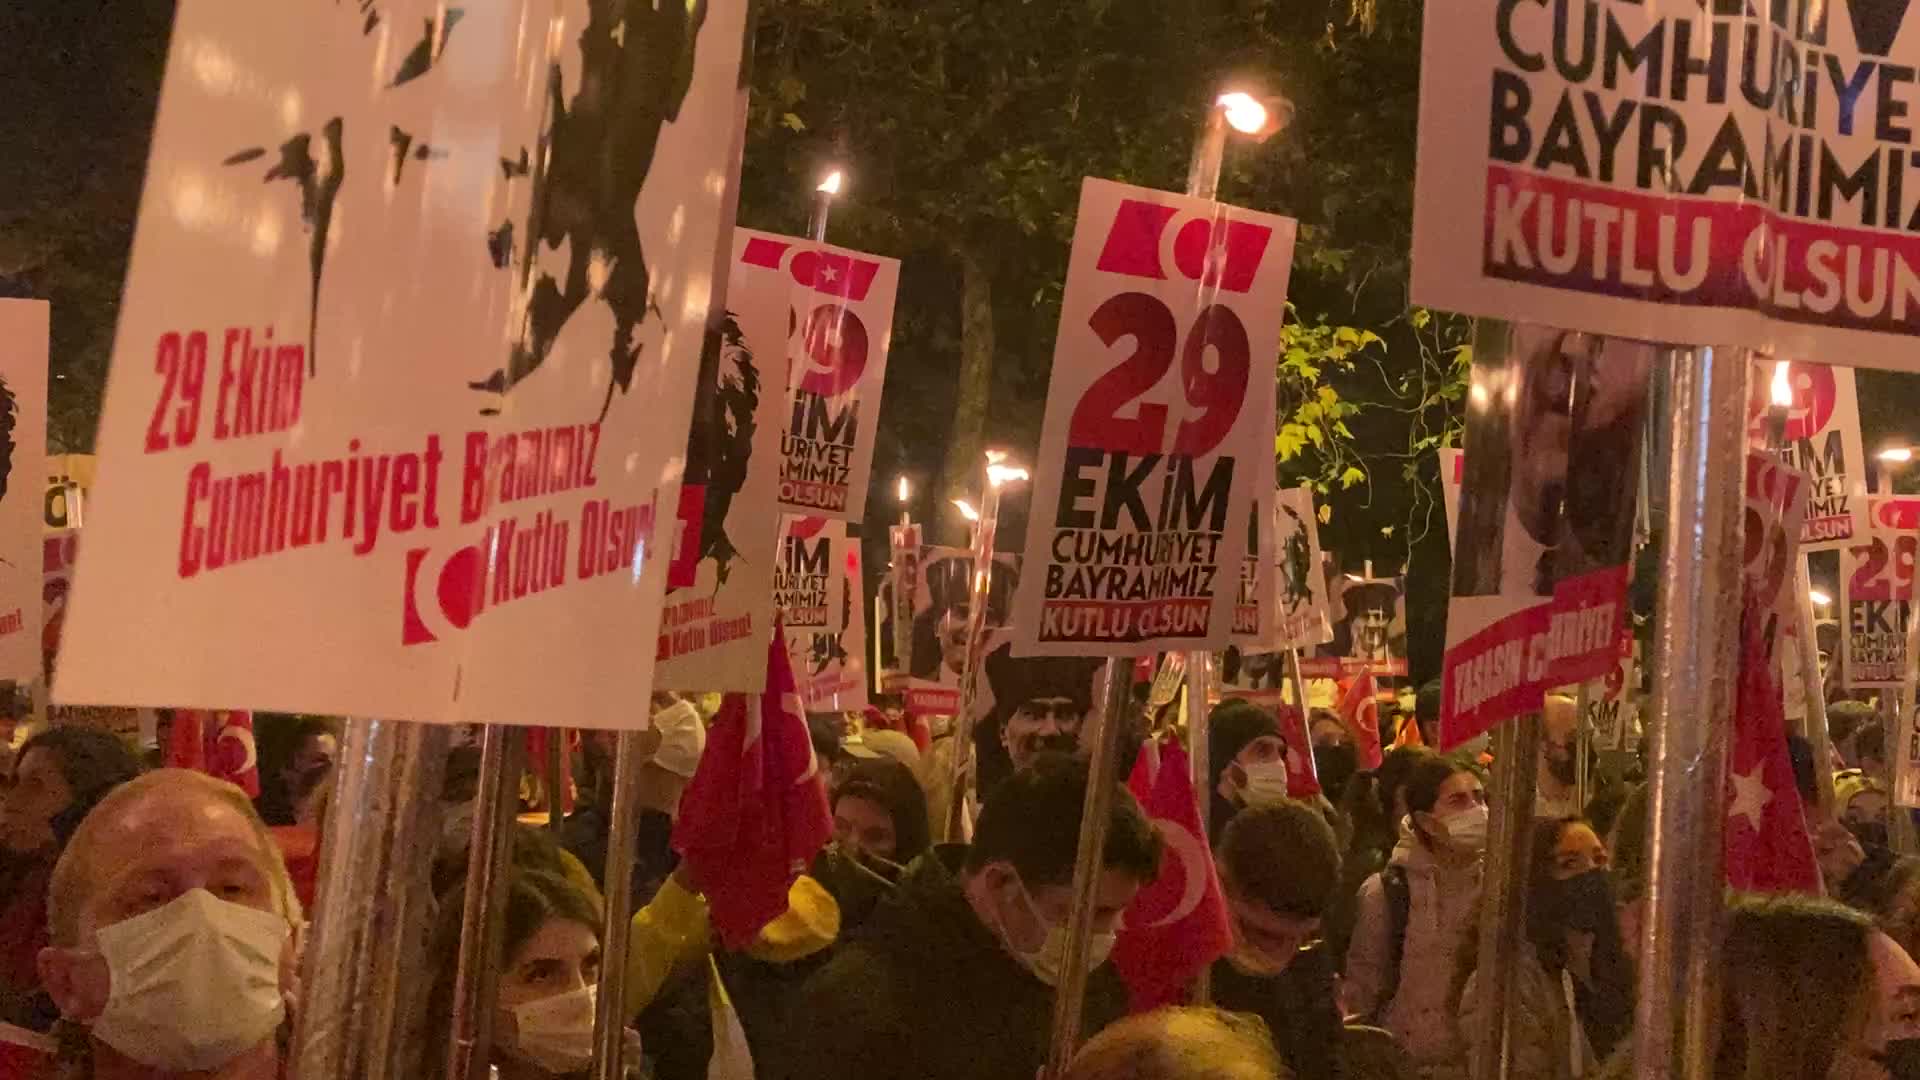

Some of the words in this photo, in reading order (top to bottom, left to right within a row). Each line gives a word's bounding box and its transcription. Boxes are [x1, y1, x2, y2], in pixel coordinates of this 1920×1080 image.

[1495, 0, 1920, 145] CUMHURİYE
[1492, 183, 1712, 293] KUTLU
[145, 331, 207, 455] 29
[214, 327, 304, 441] Ekim
[1069, 291, 1250, 459] 29
[178, 436, 443, 580] Cumhuriyet
[1055, 446, 1236, 535] EKİM
[493, 508, 569, 606] Kutlu
[1042, 604, 1133, 639] KUTLU
